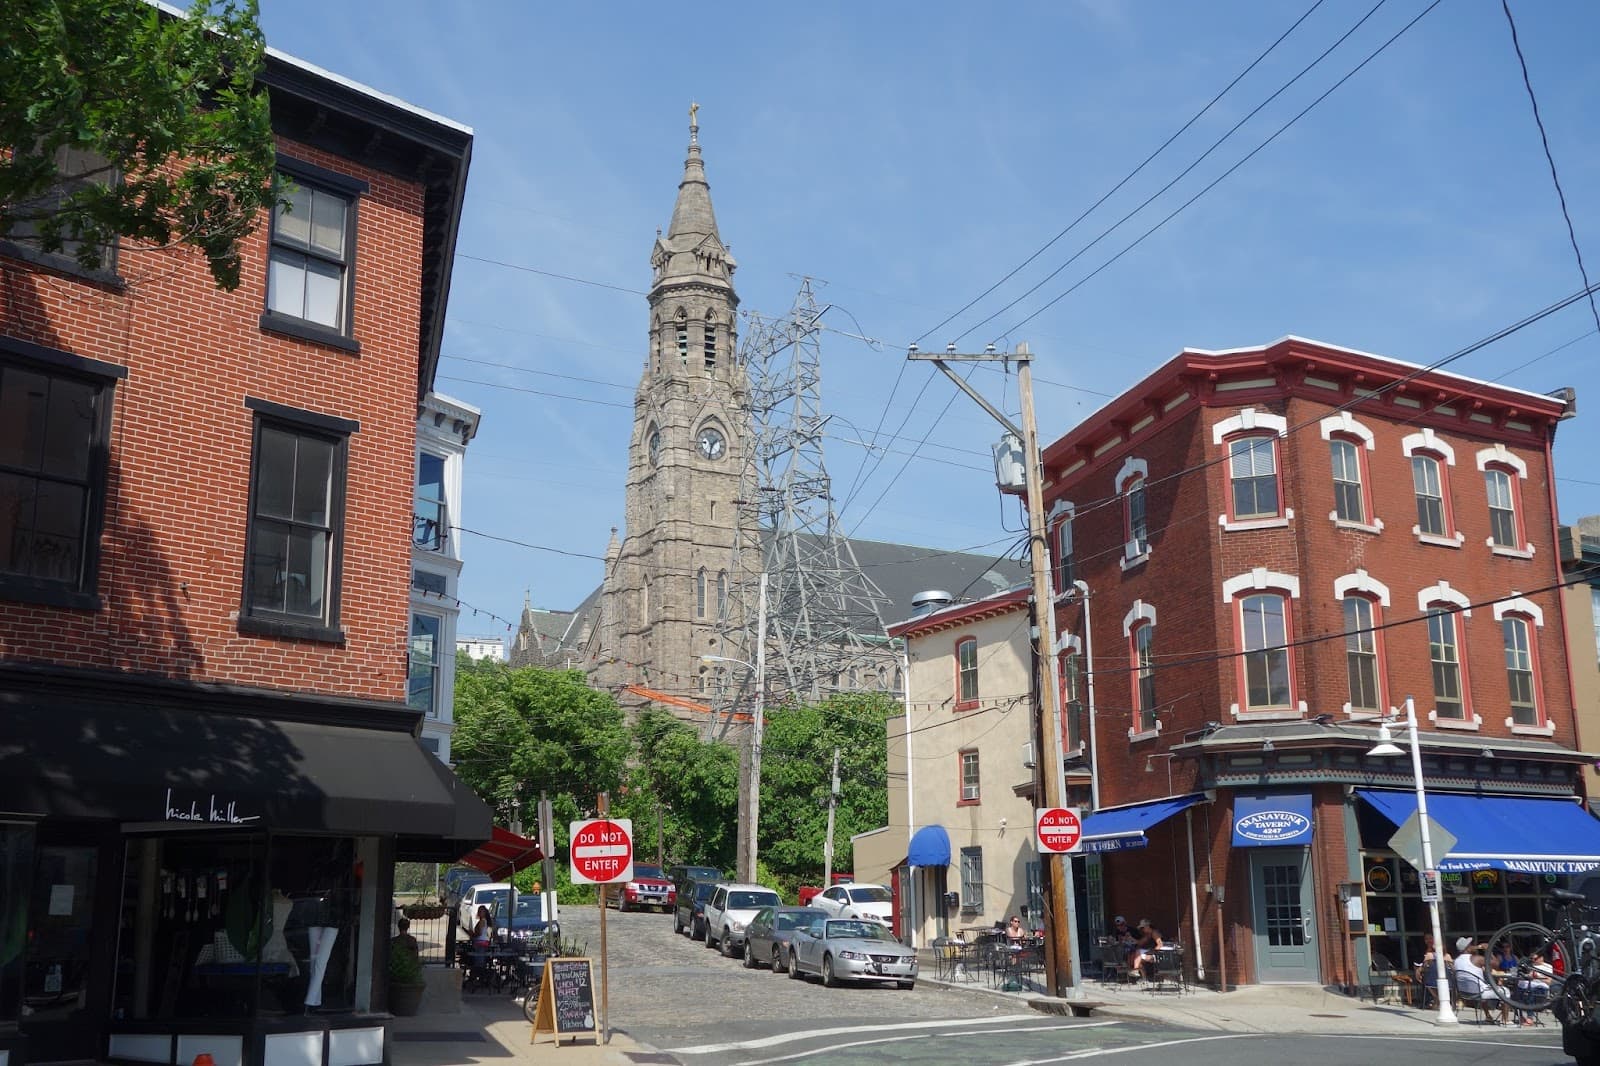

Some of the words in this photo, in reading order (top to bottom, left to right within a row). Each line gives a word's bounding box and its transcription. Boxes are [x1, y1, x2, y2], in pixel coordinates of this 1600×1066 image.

[1043, 817, 1054, 825] DO
[1058, 816, 1074, 825] NOT
[1240, 813, 1304, 828] MANAYUNK
[580, 833, 595, 843] DO
[601, 832, 622, 842] NOT
[1047, 836, 1072, 844] ENTER
[584, 859, 619, 871] ENTER
[1448, 862, 1464, 870] Food
[1503, 860, 1566, 872] MANAYUNK
